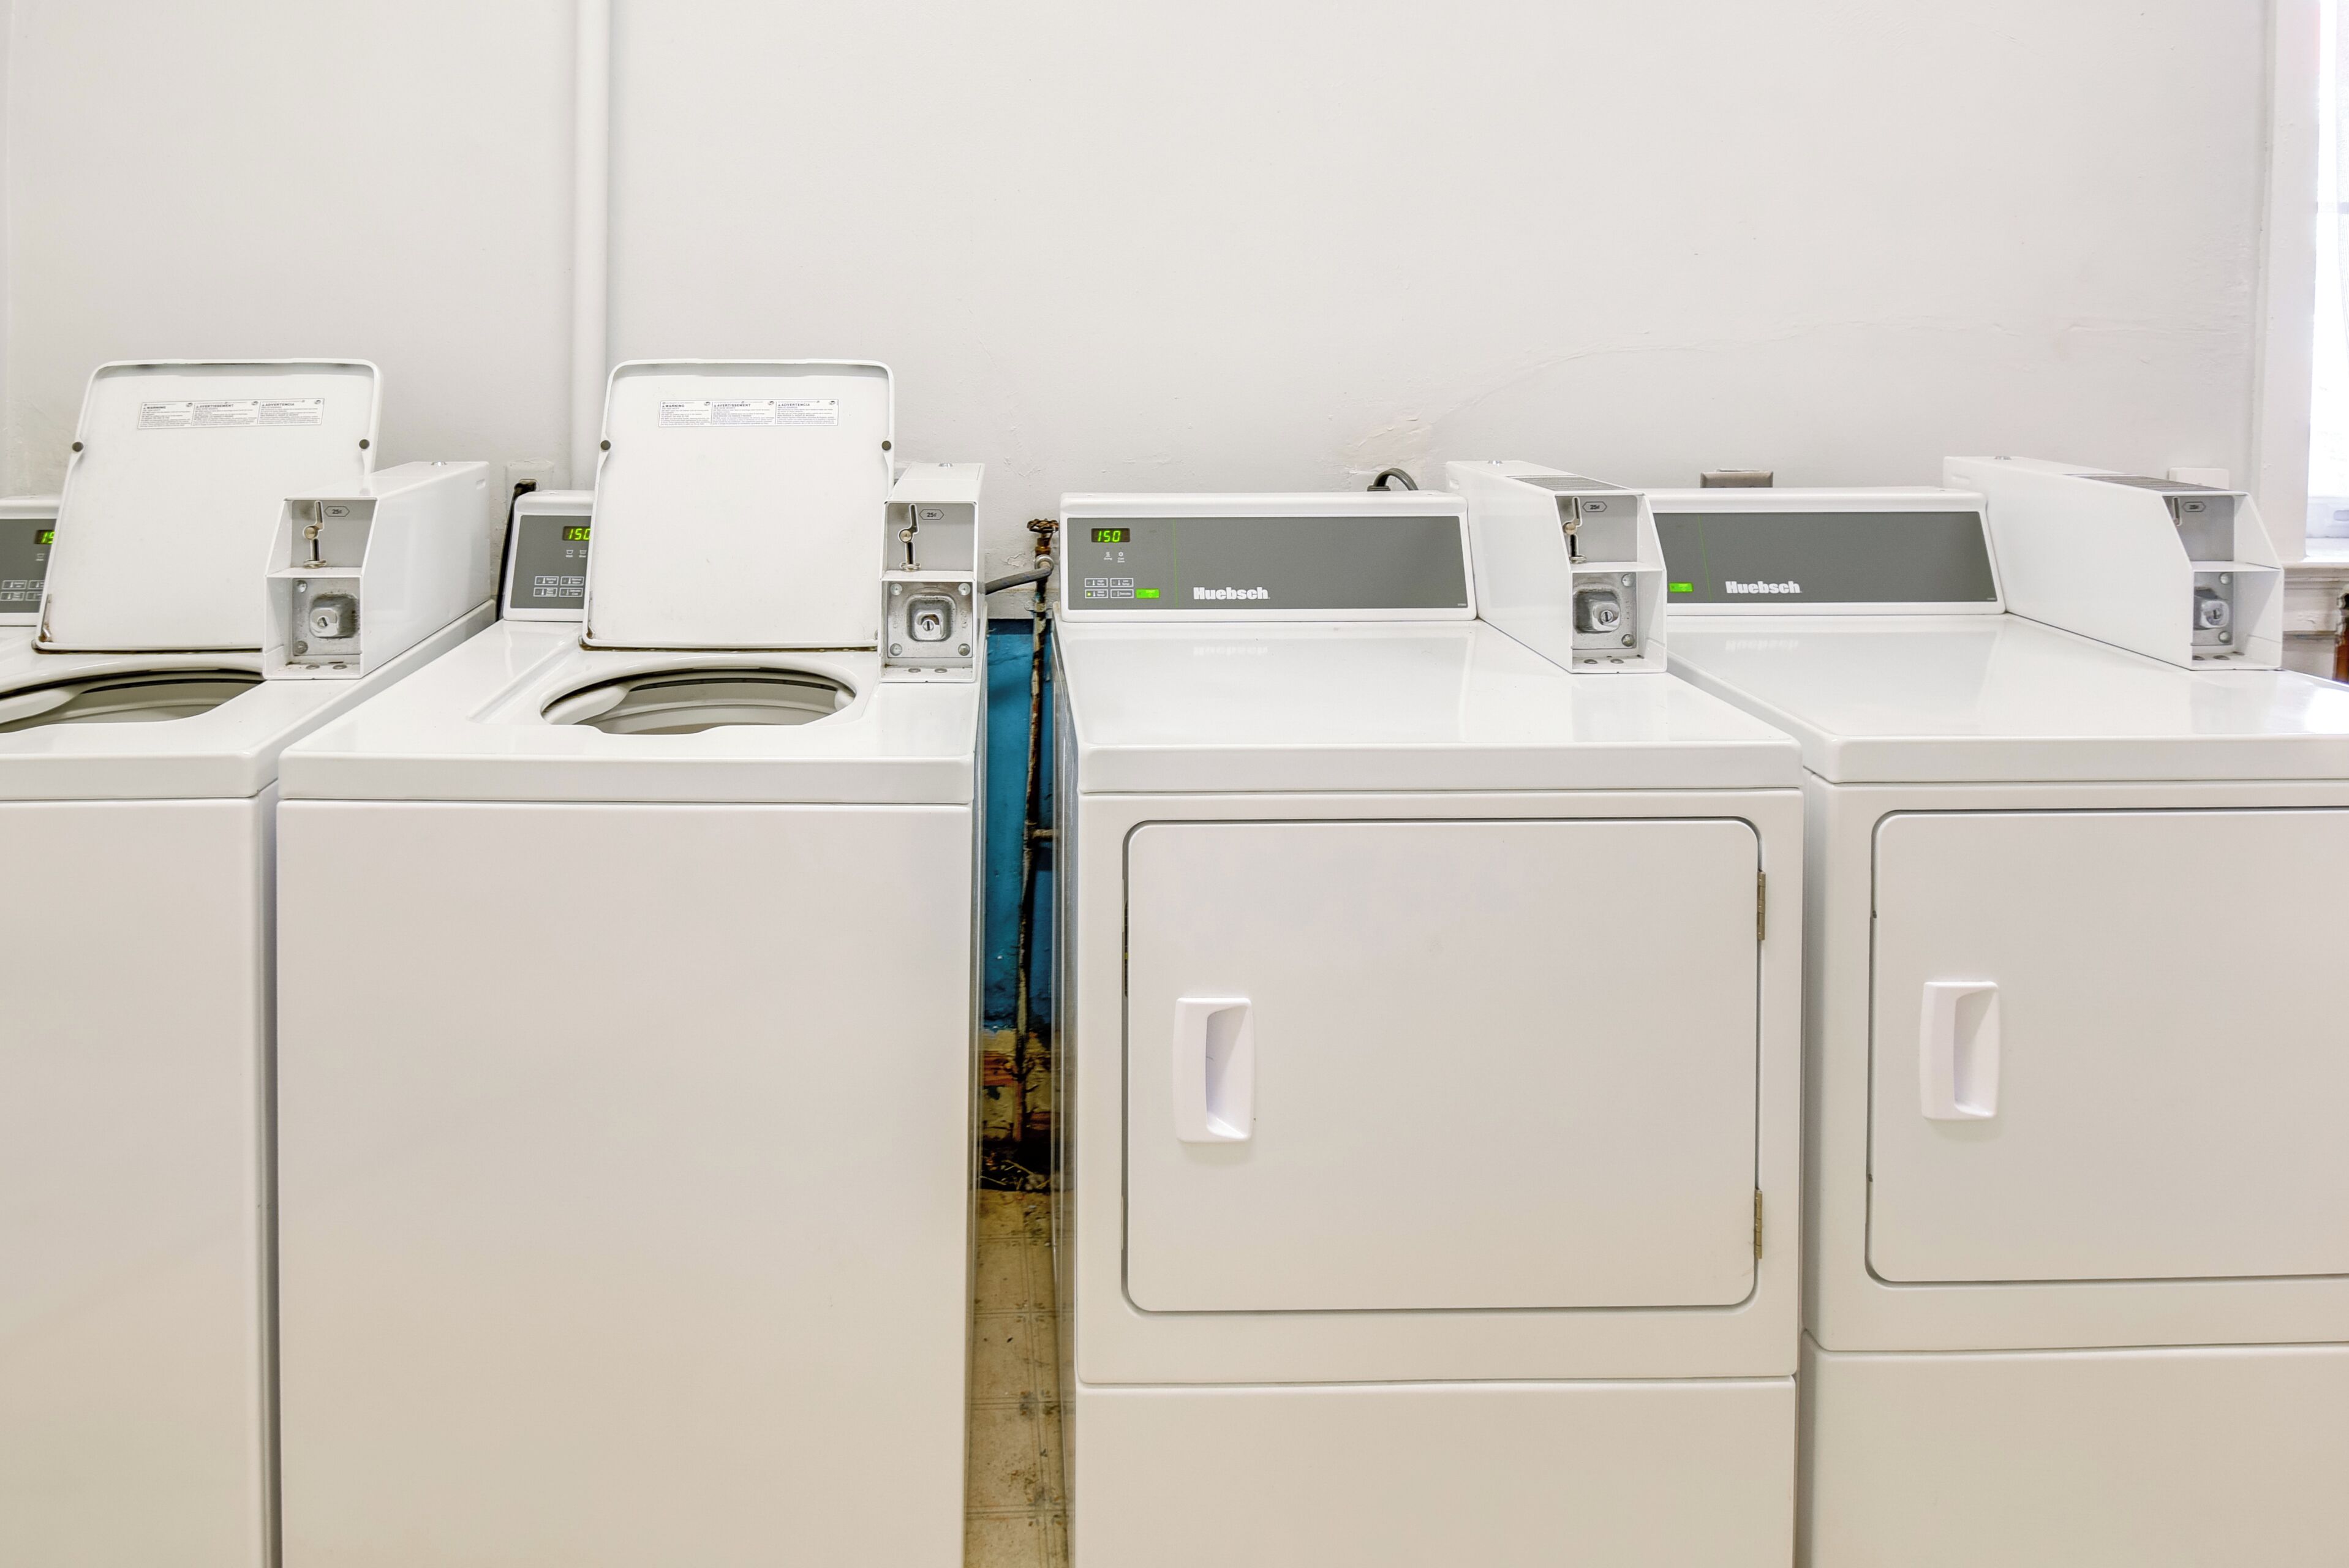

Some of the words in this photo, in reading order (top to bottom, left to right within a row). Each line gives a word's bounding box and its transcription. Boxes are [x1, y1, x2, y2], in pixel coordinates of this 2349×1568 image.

[1098, 530, 1121, 543] 150
[1193, 587, 1269, 600] Huebsch
[1725, 581, 1801, 594] Huebsch
